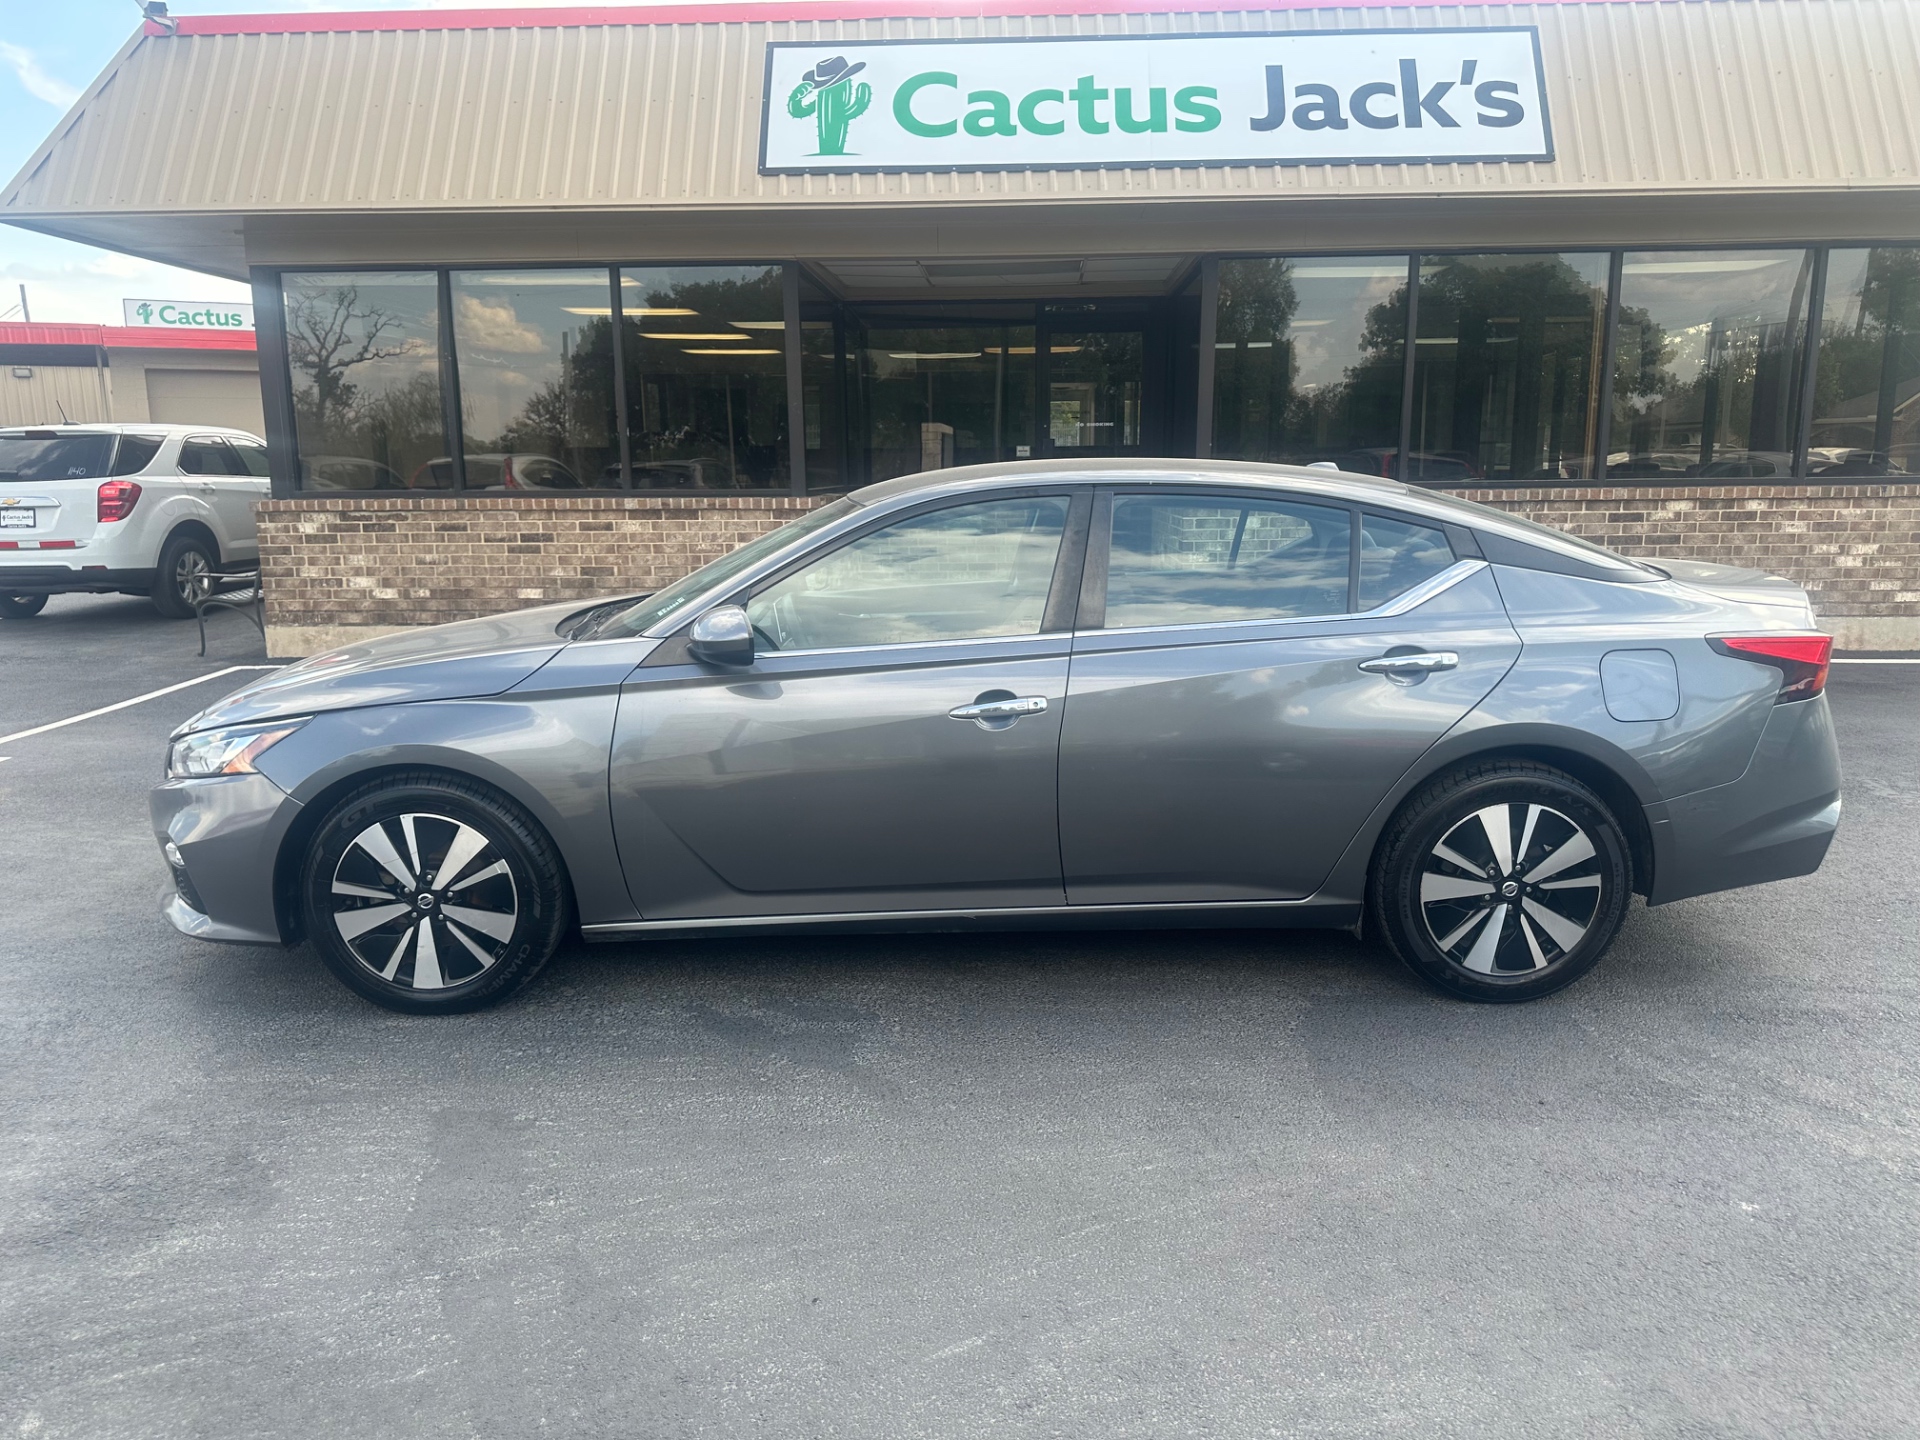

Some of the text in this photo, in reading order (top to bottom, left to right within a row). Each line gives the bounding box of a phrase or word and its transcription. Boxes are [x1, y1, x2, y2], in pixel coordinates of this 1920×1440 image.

[892, 58, 1525, 139] Cactus Jack's
[158, 304, 244, 328] Cactus
